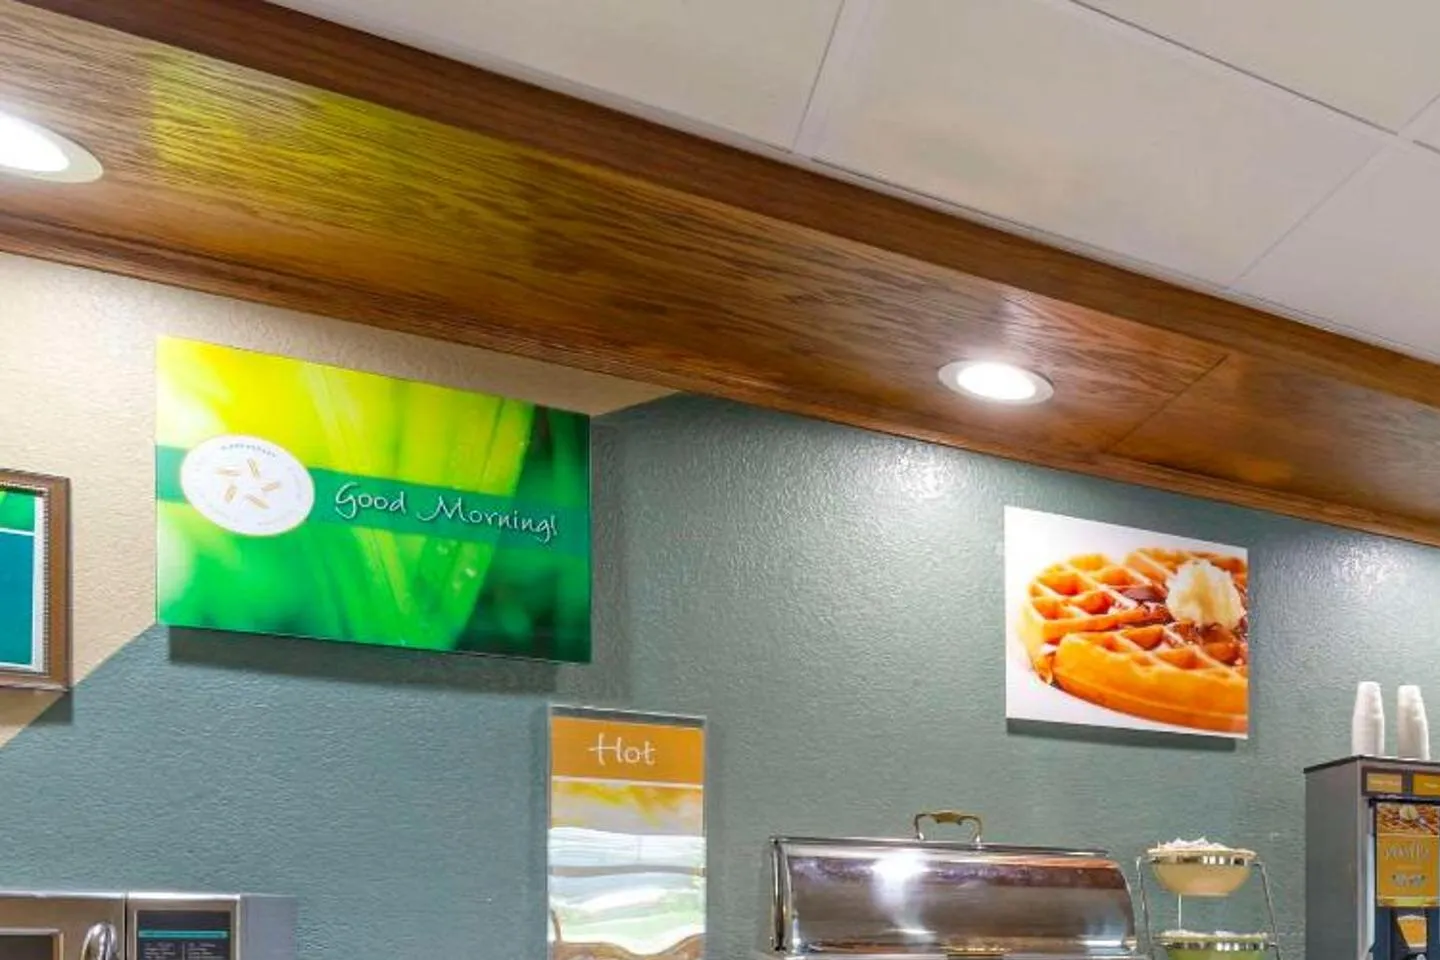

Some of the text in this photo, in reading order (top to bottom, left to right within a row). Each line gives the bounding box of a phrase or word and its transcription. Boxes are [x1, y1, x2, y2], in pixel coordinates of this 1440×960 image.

[335, 482, 558, 544] Good Morning!
[588, 732, 656, 766] Hot
